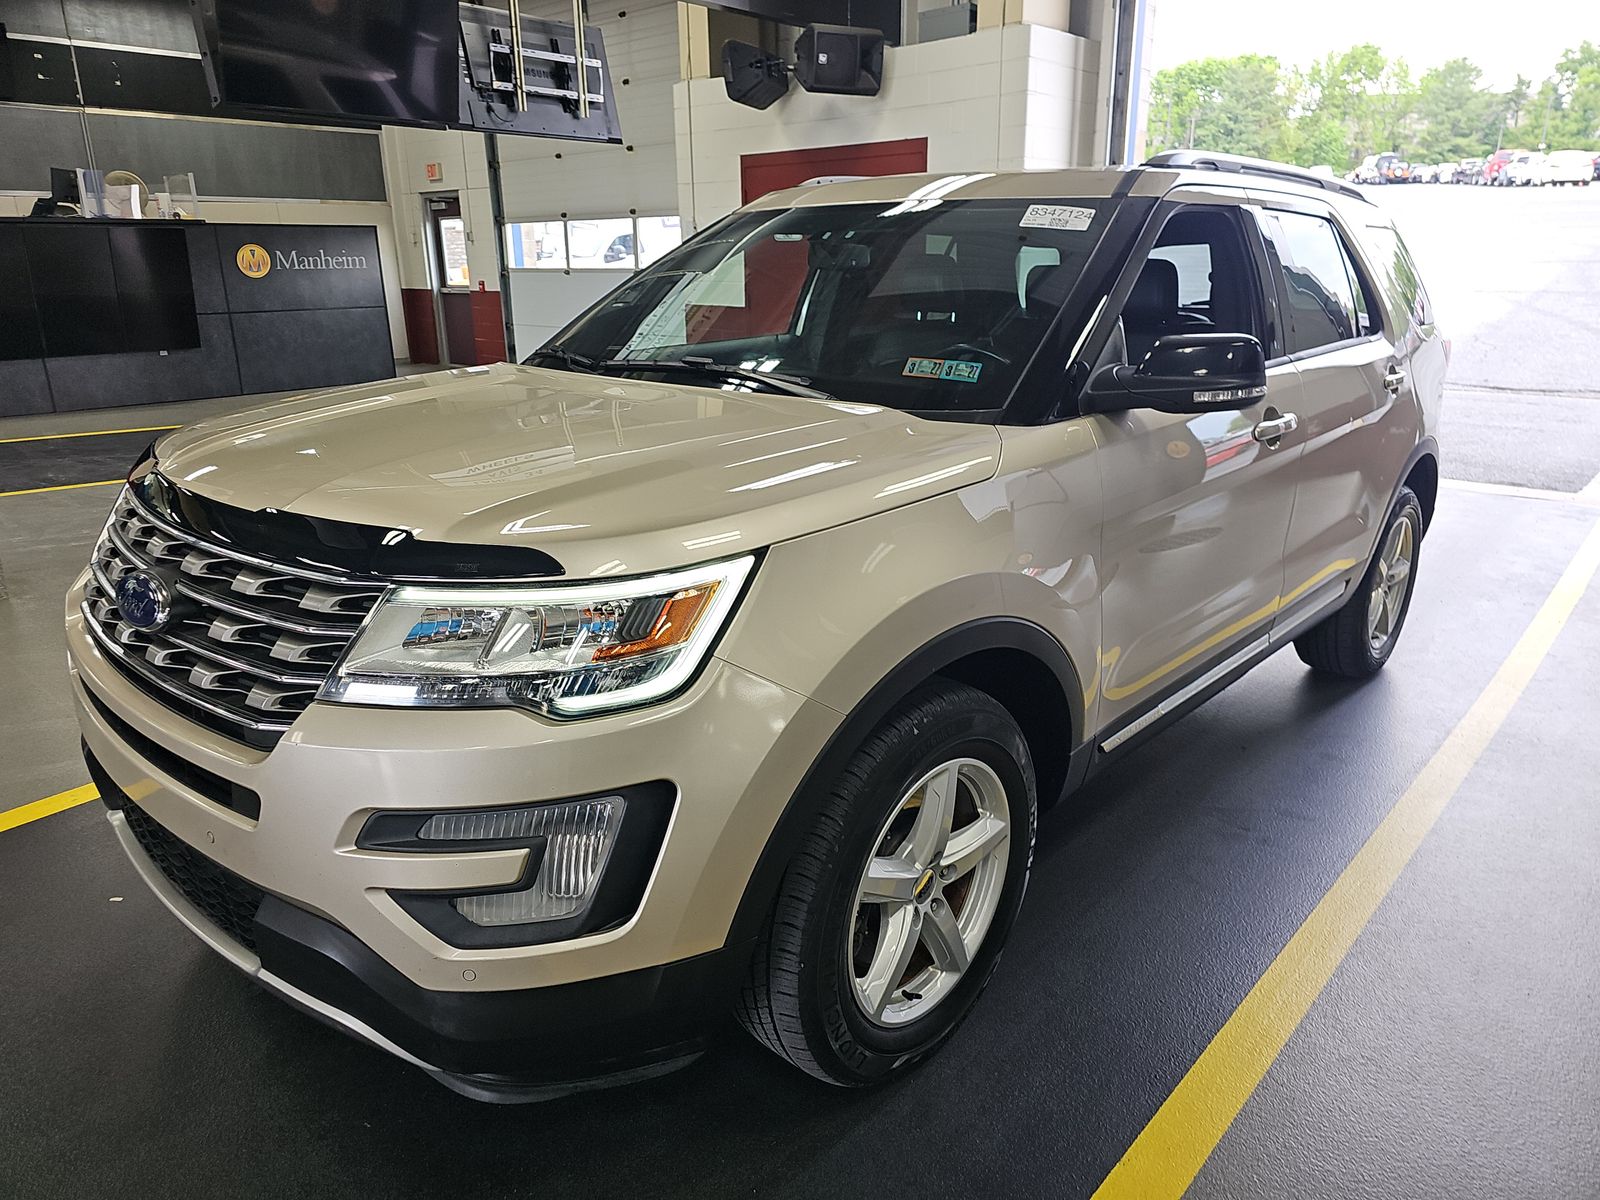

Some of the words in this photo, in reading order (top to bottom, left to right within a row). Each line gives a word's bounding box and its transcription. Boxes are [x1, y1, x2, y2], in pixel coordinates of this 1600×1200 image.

[1029, 207, 1094, 220] 8347124
[275, 249, 368, 270] Manheim
[908, 362, 916, 374] 3
[930, 361, 942, 375] 27
[945, 365, 953, 377] 3
[967, 365, 979, 379] 27
